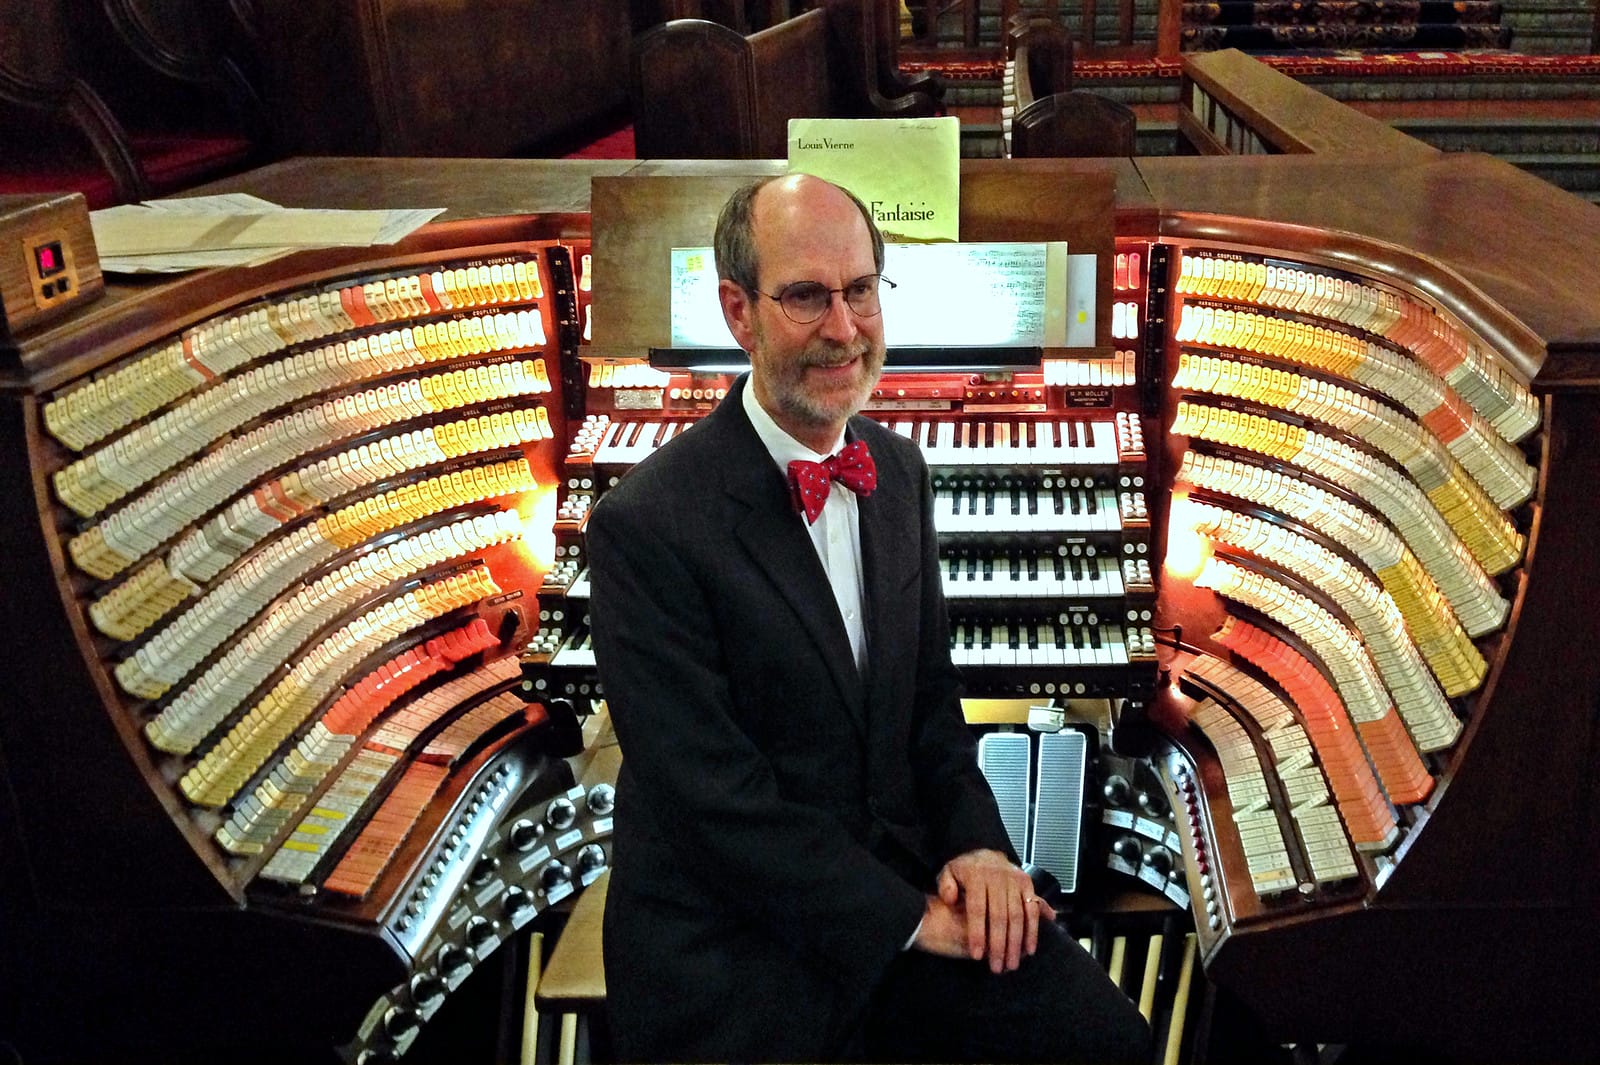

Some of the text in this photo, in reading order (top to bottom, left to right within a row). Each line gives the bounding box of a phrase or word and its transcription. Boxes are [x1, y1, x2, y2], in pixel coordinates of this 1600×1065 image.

[798, 138, 855, 150] Louis Vierne
[871, 201, 935, 222] Fantaisie
